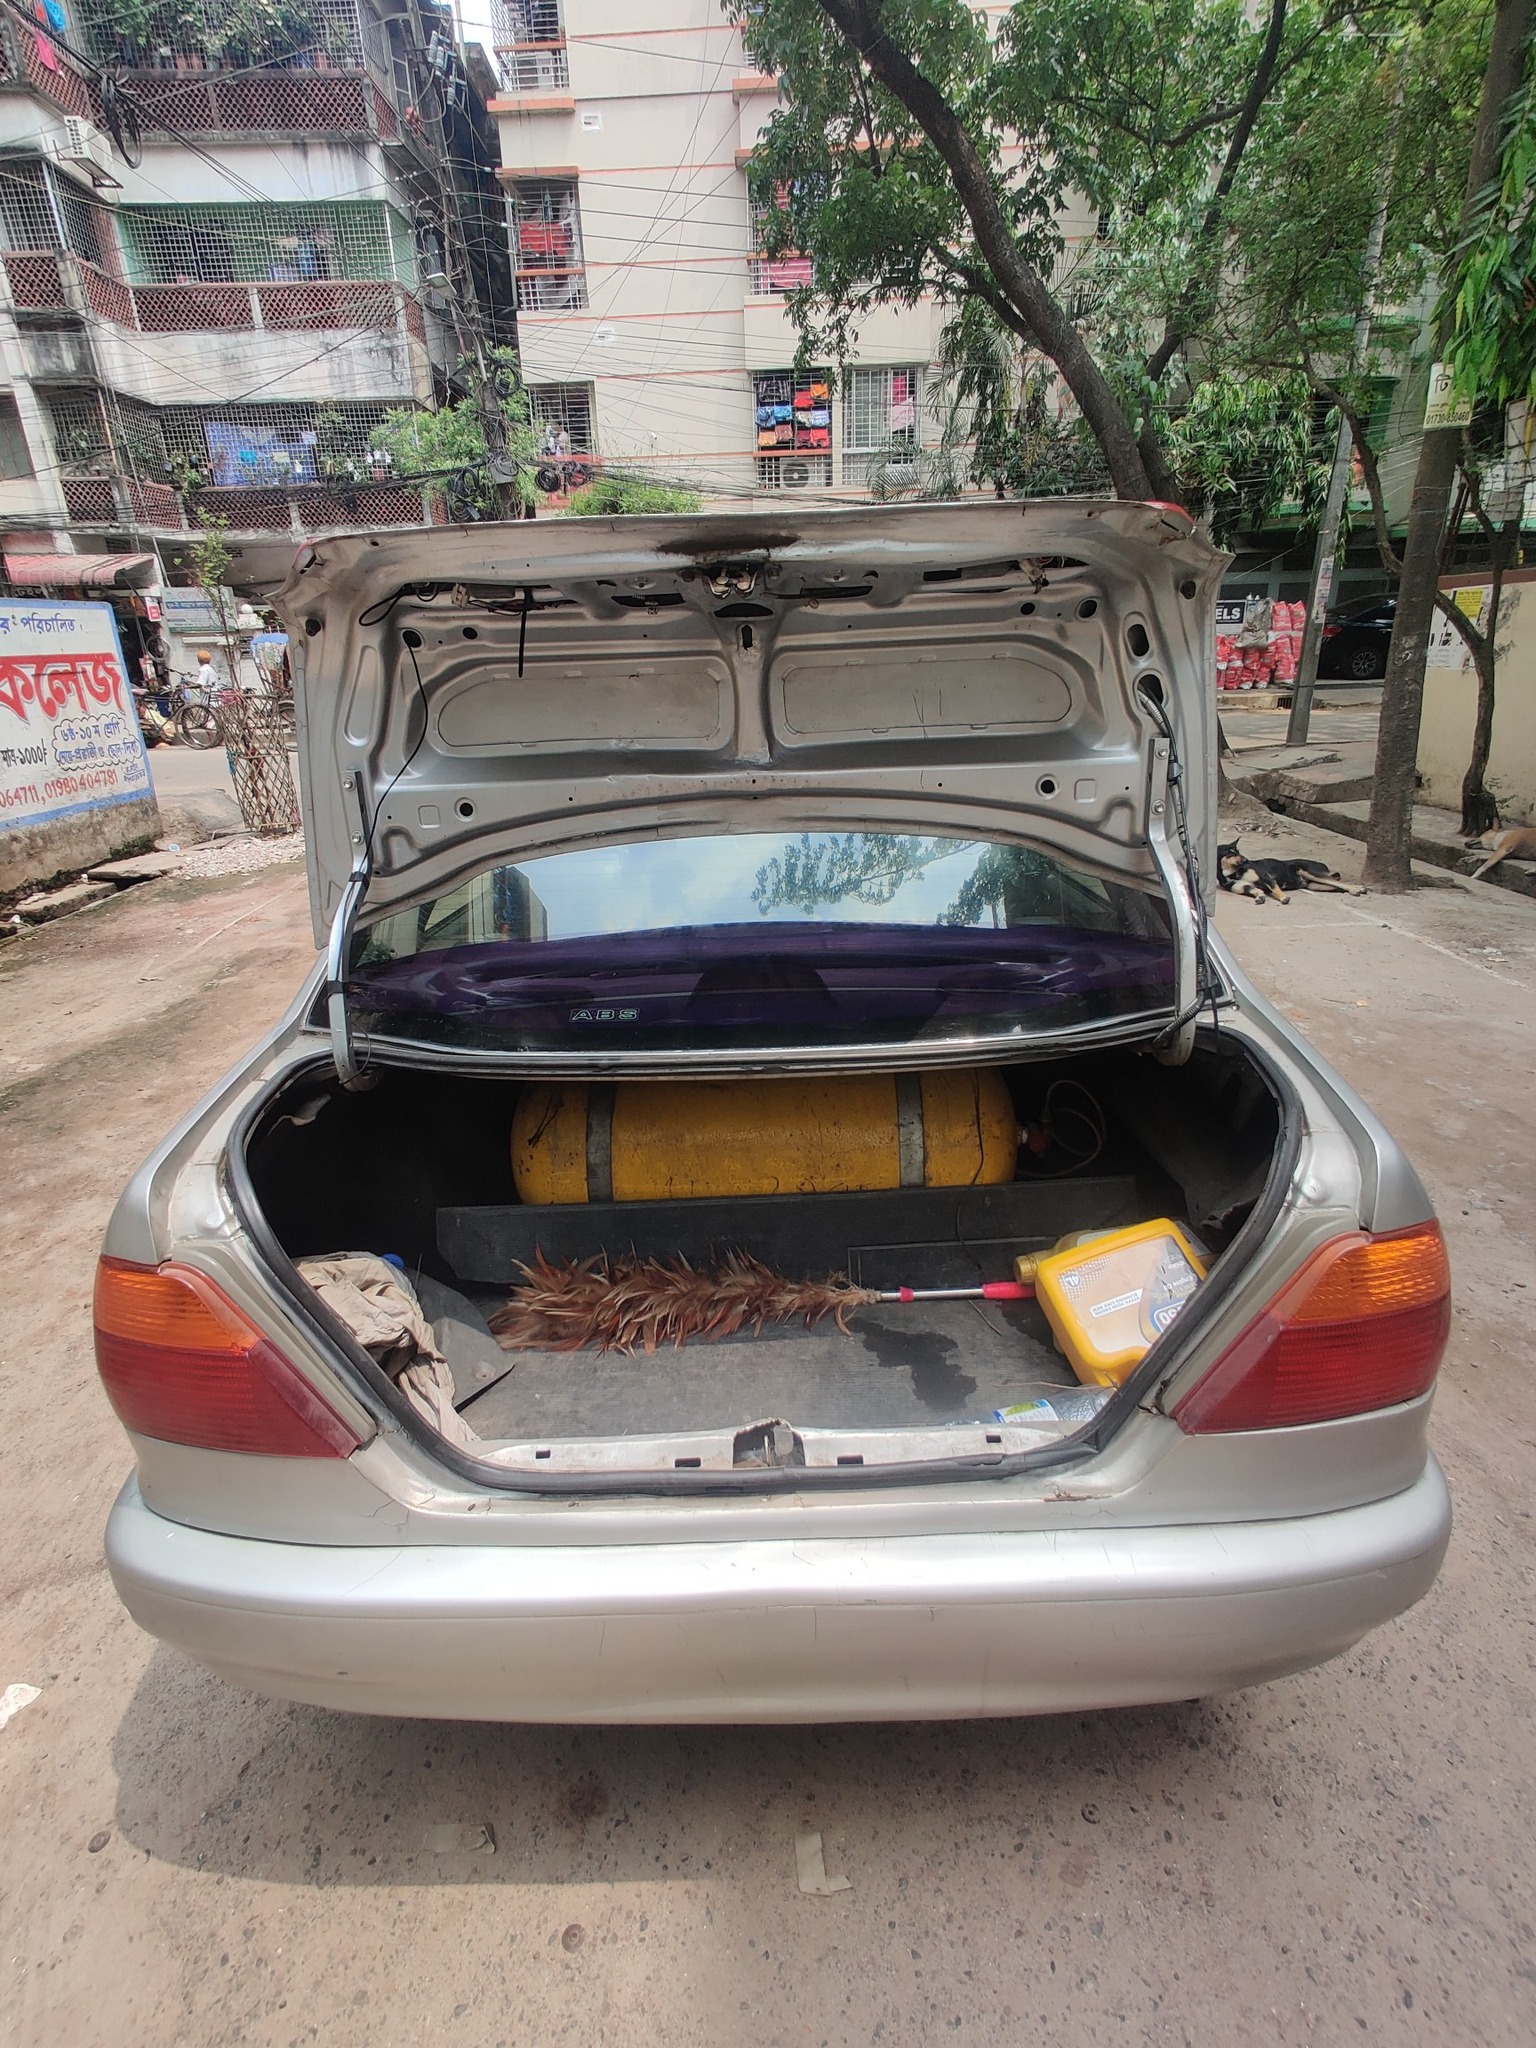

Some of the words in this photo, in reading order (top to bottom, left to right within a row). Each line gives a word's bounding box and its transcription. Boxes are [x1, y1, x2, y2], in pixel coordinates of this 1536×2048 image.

[0, 652, 125, 723] কলেজ
[571, 1009, 639, 1021] ABS
[1065, 1274, 1080, 1287] 4L
